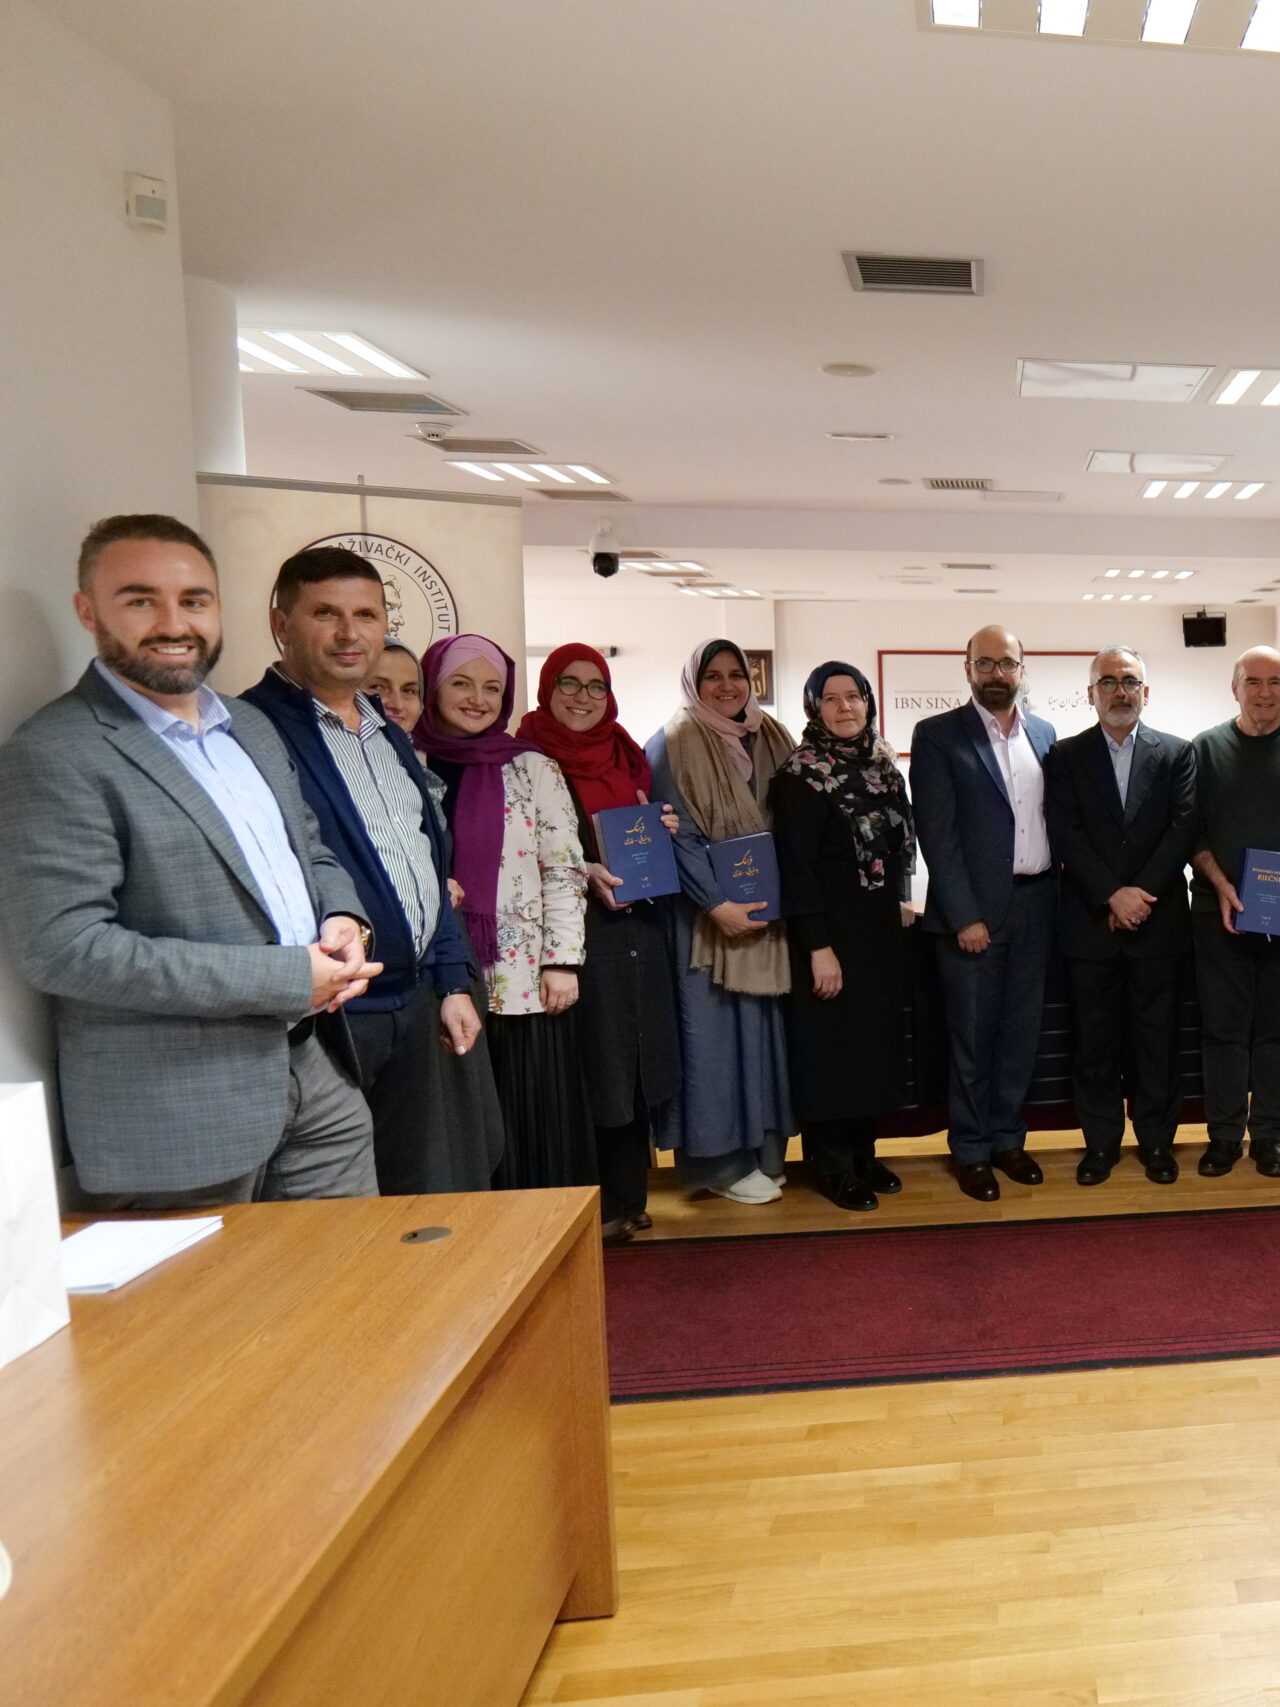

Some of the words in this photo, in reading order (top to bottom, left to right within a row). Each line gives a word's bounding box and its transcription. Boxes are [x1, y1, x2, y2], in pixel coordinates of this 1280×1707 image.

[414, 565, 451, 633] INSTITUT
[894, 697, 922, 709] IBN
[926, 697, 962, 710] SINA
